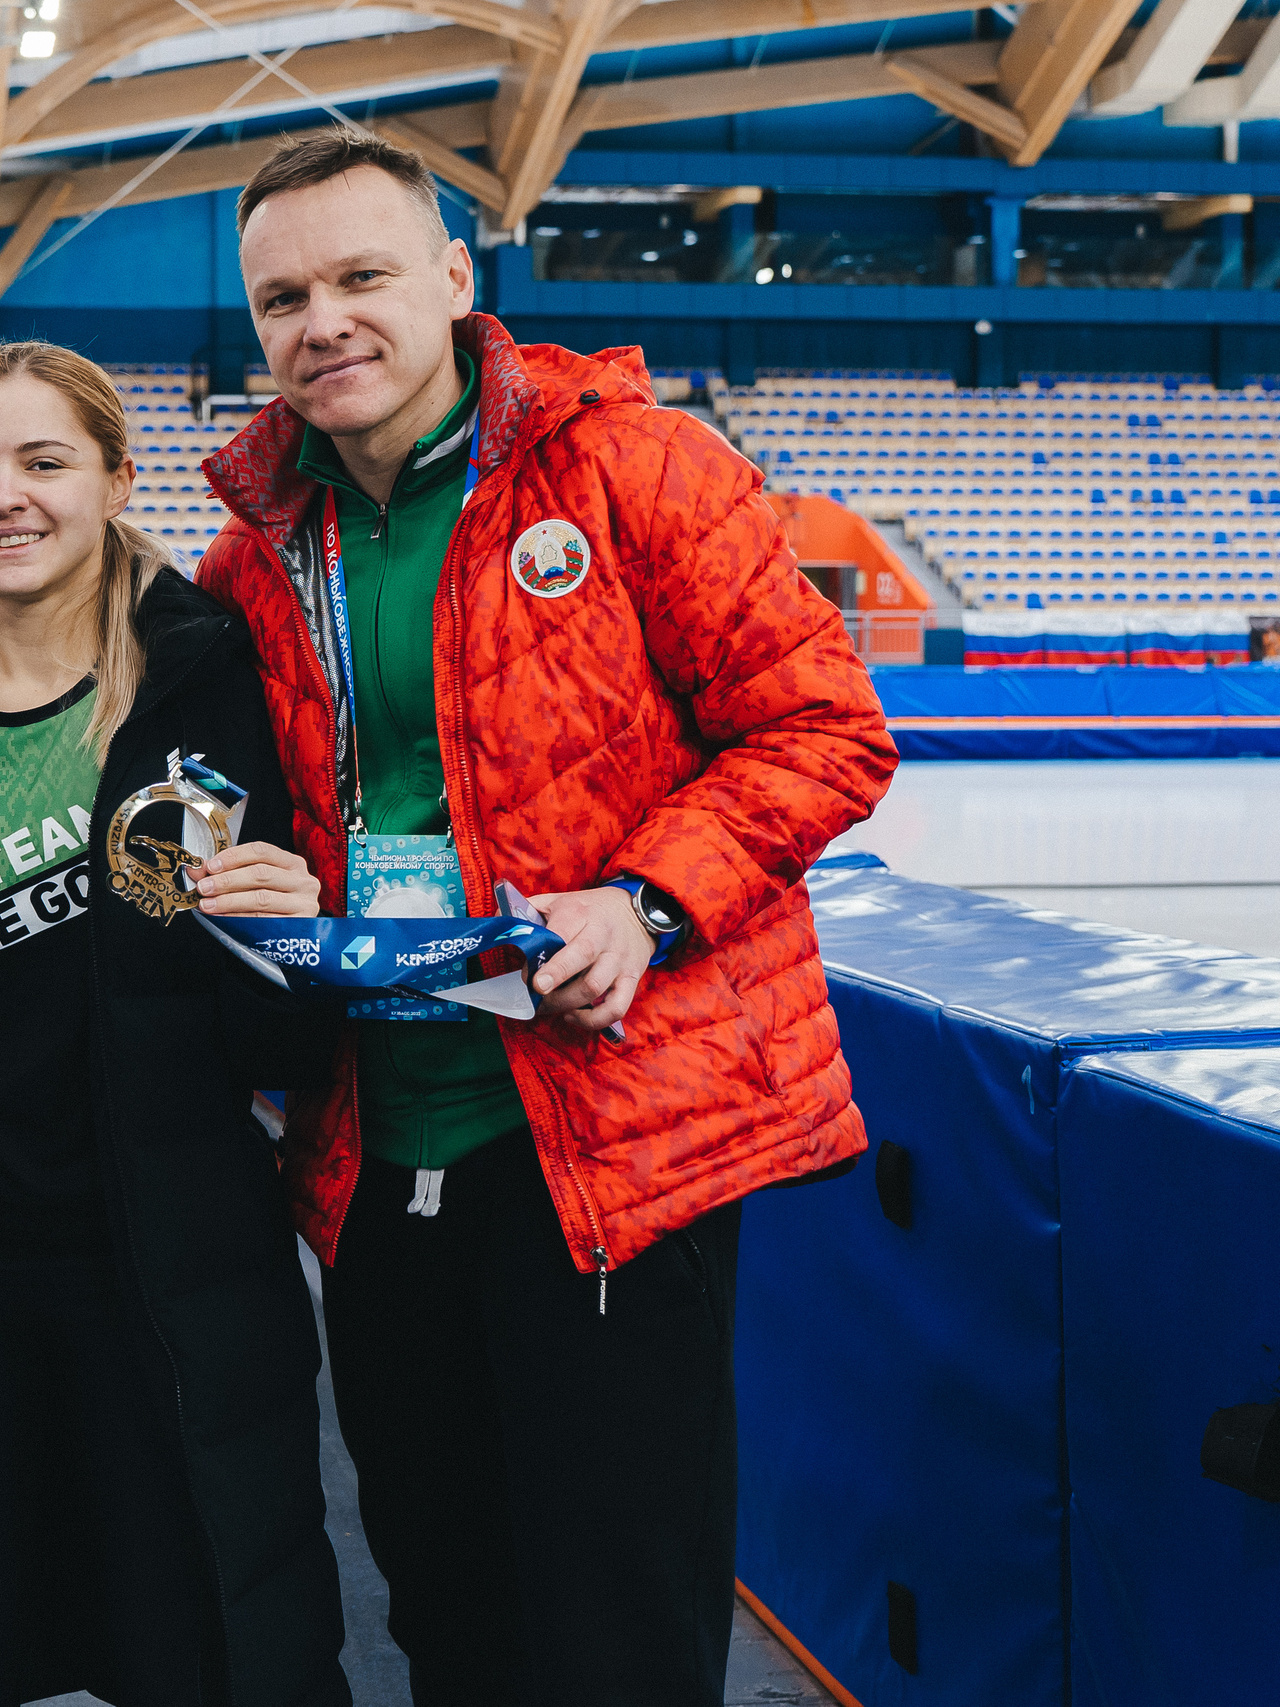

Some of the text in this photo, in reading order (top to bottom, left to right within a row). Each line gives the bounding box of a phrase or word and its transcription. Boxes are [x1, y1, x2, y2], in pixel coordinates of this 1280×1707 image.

[326, 523, 354, 697] ПО КОНЬКОБЕЖНОМ
[355, 862, 454, 870] КОНЬКОБЕЖНОМУ СПОРТУ
[127, 861, 182, 902] KEMEROVO
[106, 870, 177, 926] OPEN
[276, 938, 320, 953] OPEN
[440, 935, 483, 952] OPEN
[250, 947, 320, 967] MEROVO
[396, 943, 479, 967] KEMEROVO
